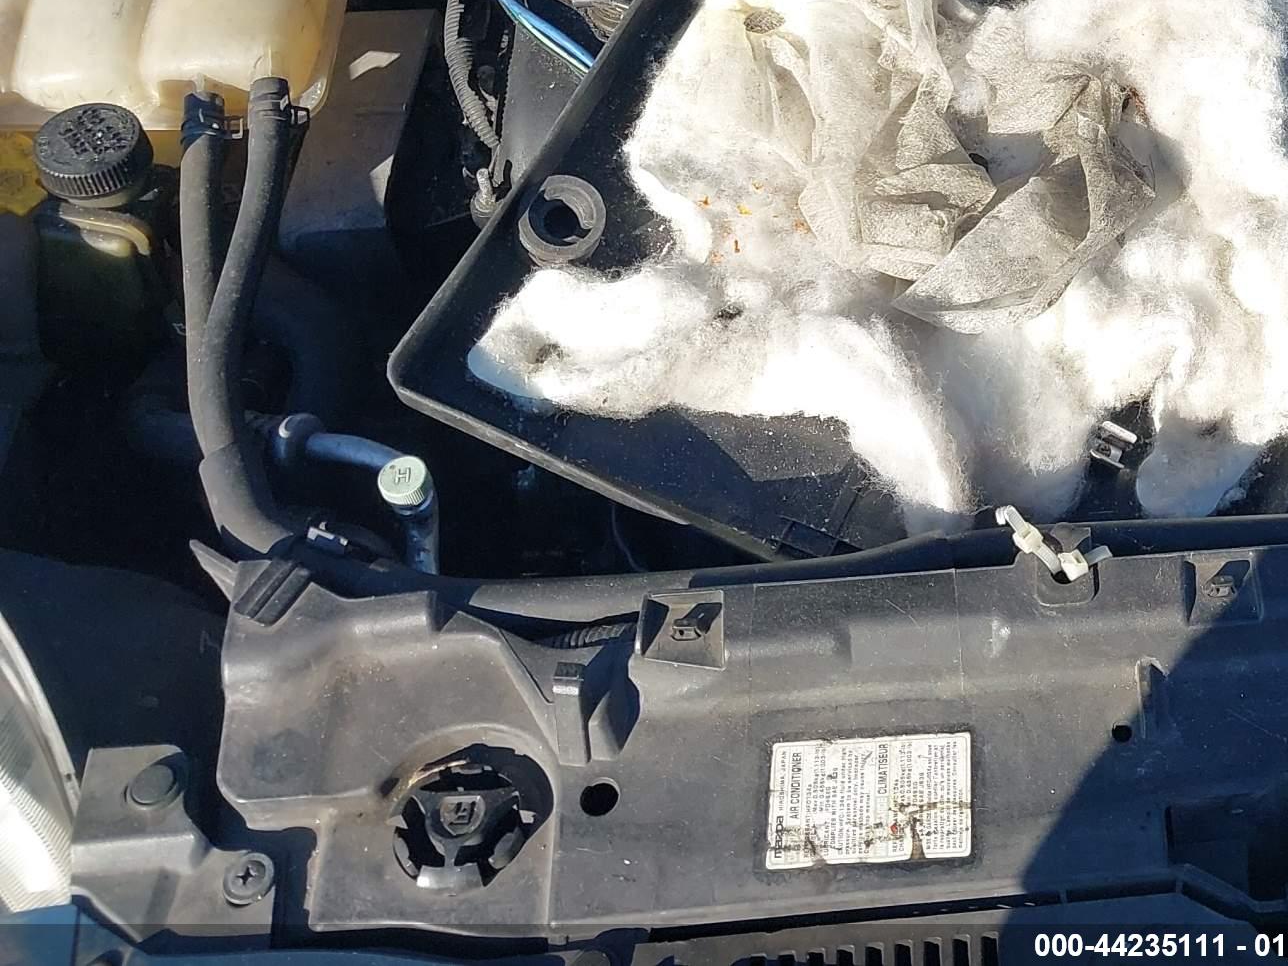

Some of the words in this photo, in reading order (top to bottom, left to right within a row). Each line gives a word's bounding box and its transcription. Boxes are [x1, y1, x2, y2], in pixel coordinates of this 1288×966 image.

[790, 752, 802, 804] CONDITIONER
[877, 743, 888, 794] CLIMATISEUR
[789, 806, 800, 819] AIR
[773, 815, 784, 858] mazda
